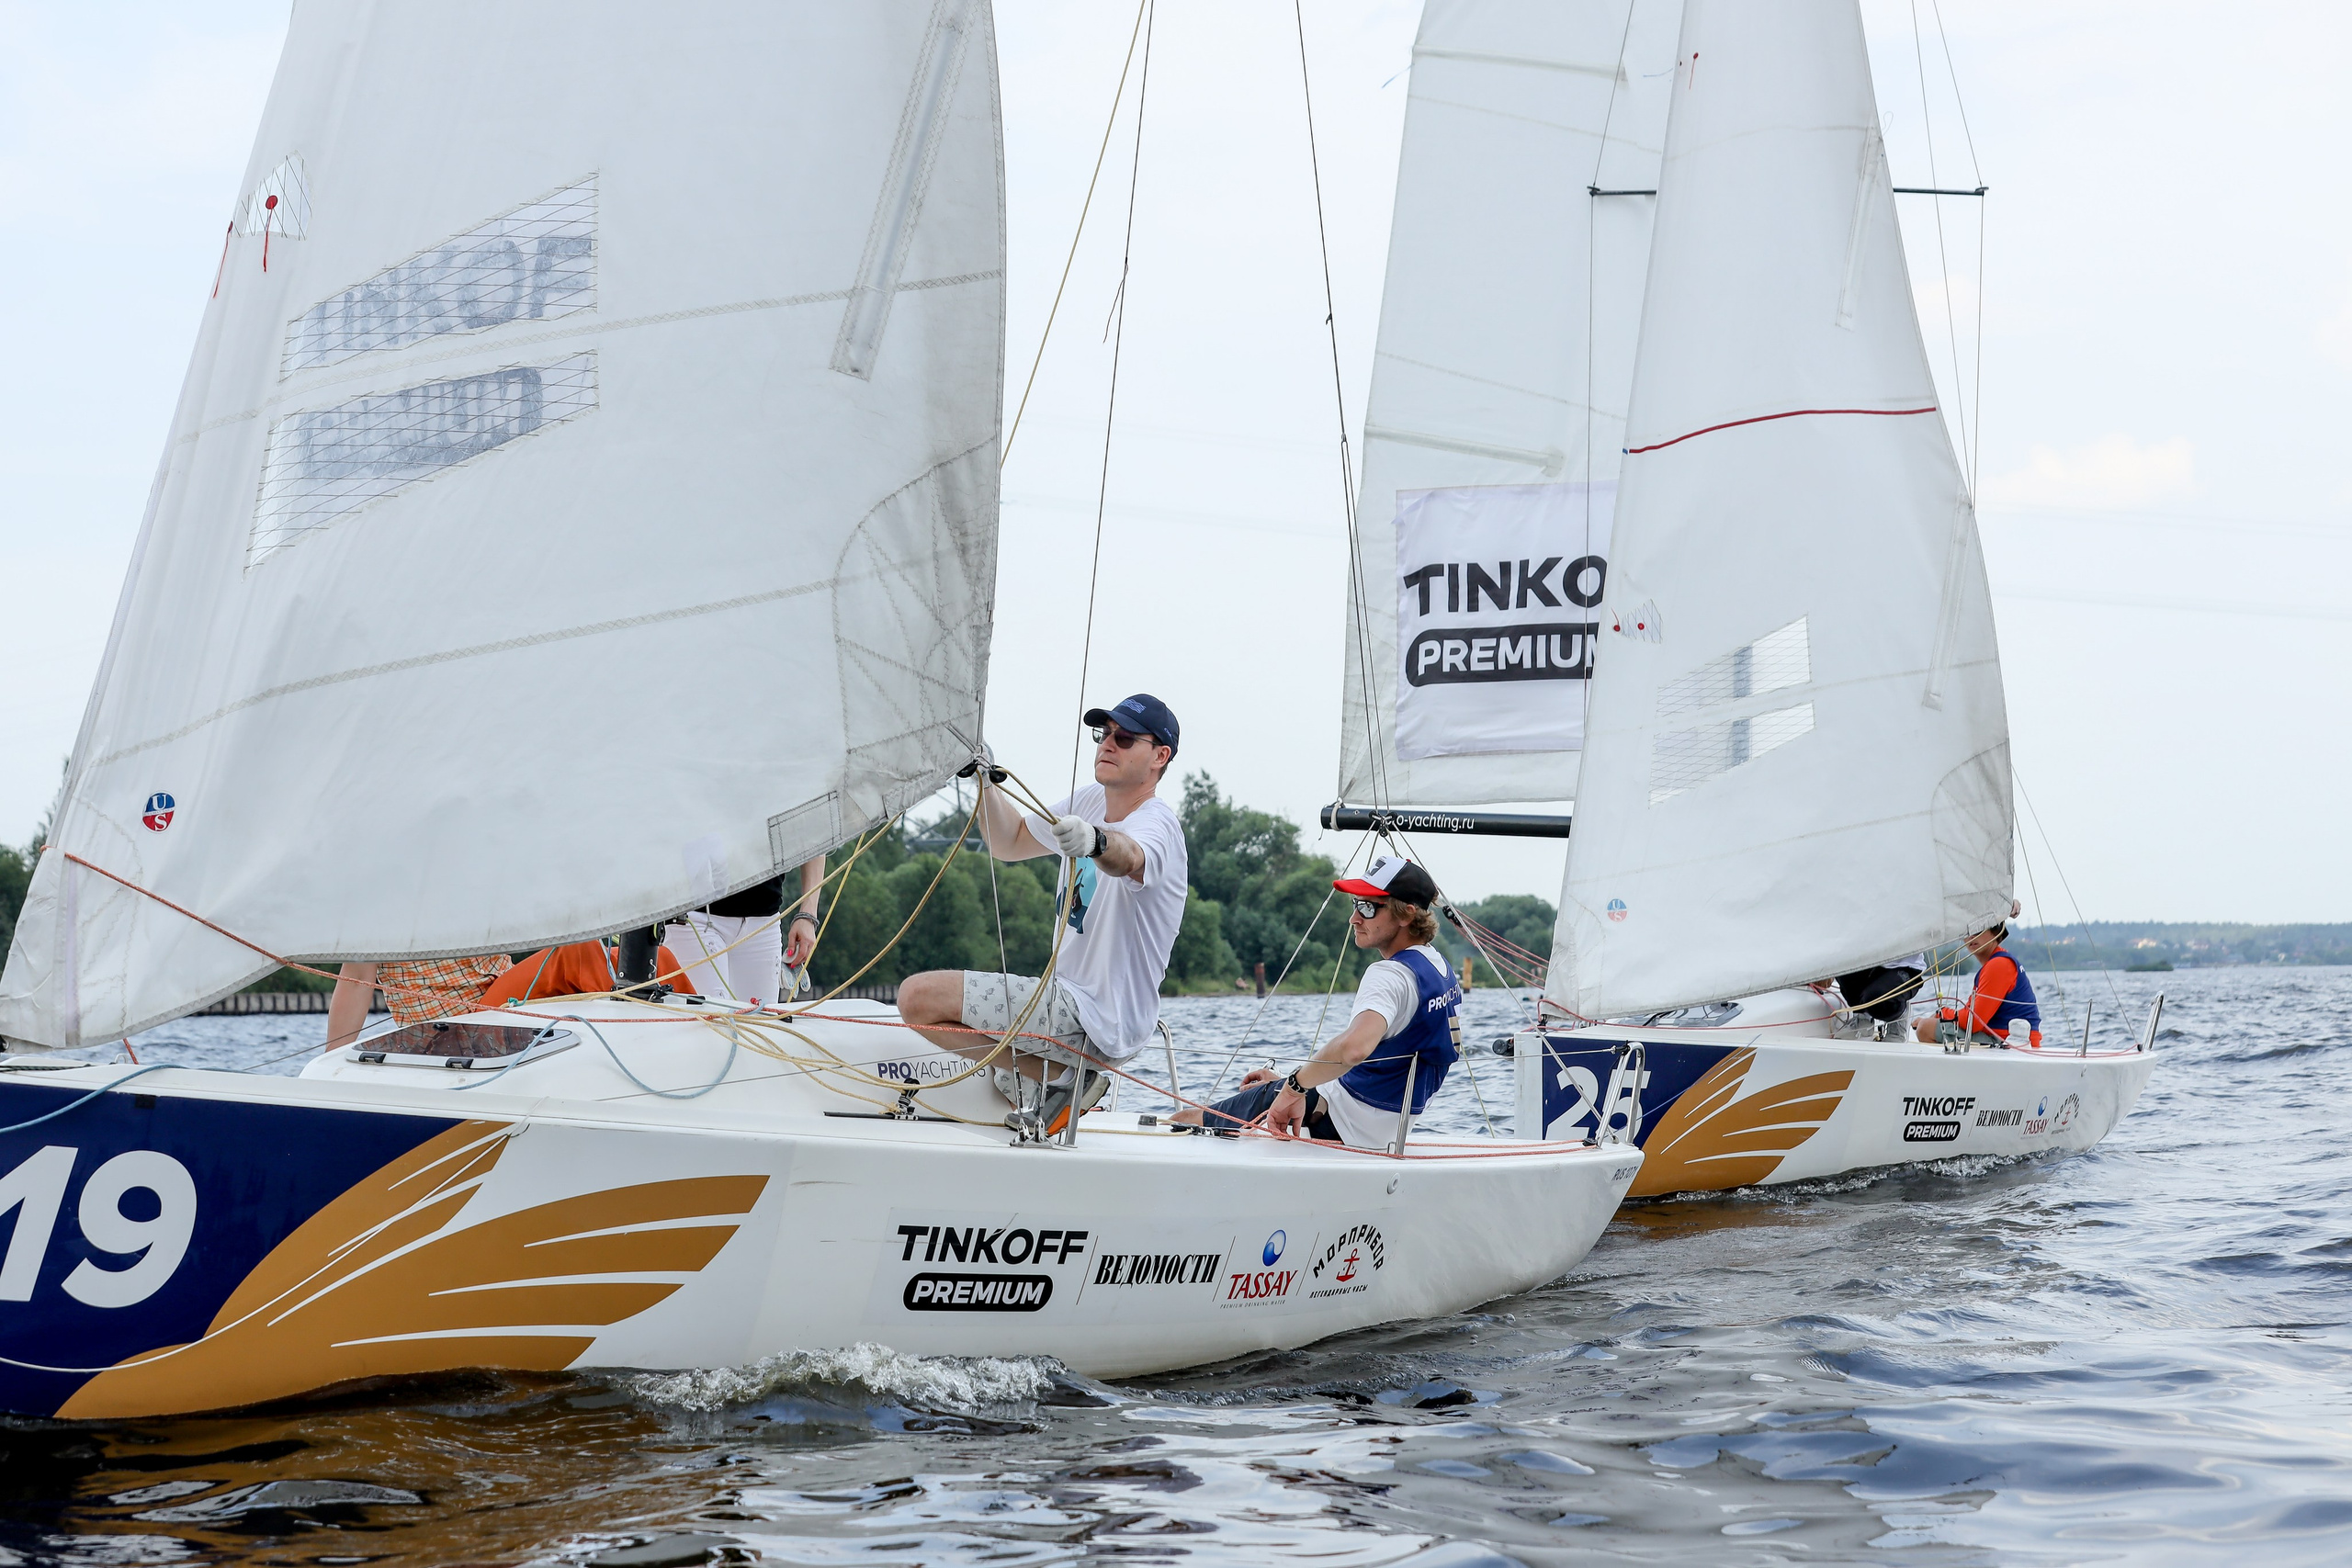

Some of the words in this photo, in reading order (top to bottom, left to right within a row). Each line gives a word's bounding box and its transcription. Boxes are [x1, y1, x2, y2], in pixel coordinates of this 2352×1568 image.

[1403, 555, 1608, 617] TINKO
[1903, 1096, 1976, 1116] TINKOFF
[1975, 1109, 2024, 1129] ВЕДОМОСТИ
[1905, 1124, 1959, 1139] PREMIUM
[2022, 1118, 2051, 1135] TASSAY
[0, 1145, 198, 1309] 19
[897, 1224, 1090, 1265] TINKOFF
[1312, 1224, 1385, 1280] МОРПРИБОР
[1093, 1253, 1222, 1289] ВЕДОМОСТИ
[1227, 1269, 1299, 1300] TASSAY
[911, 1280, 1046, 1305] PREMIUM
